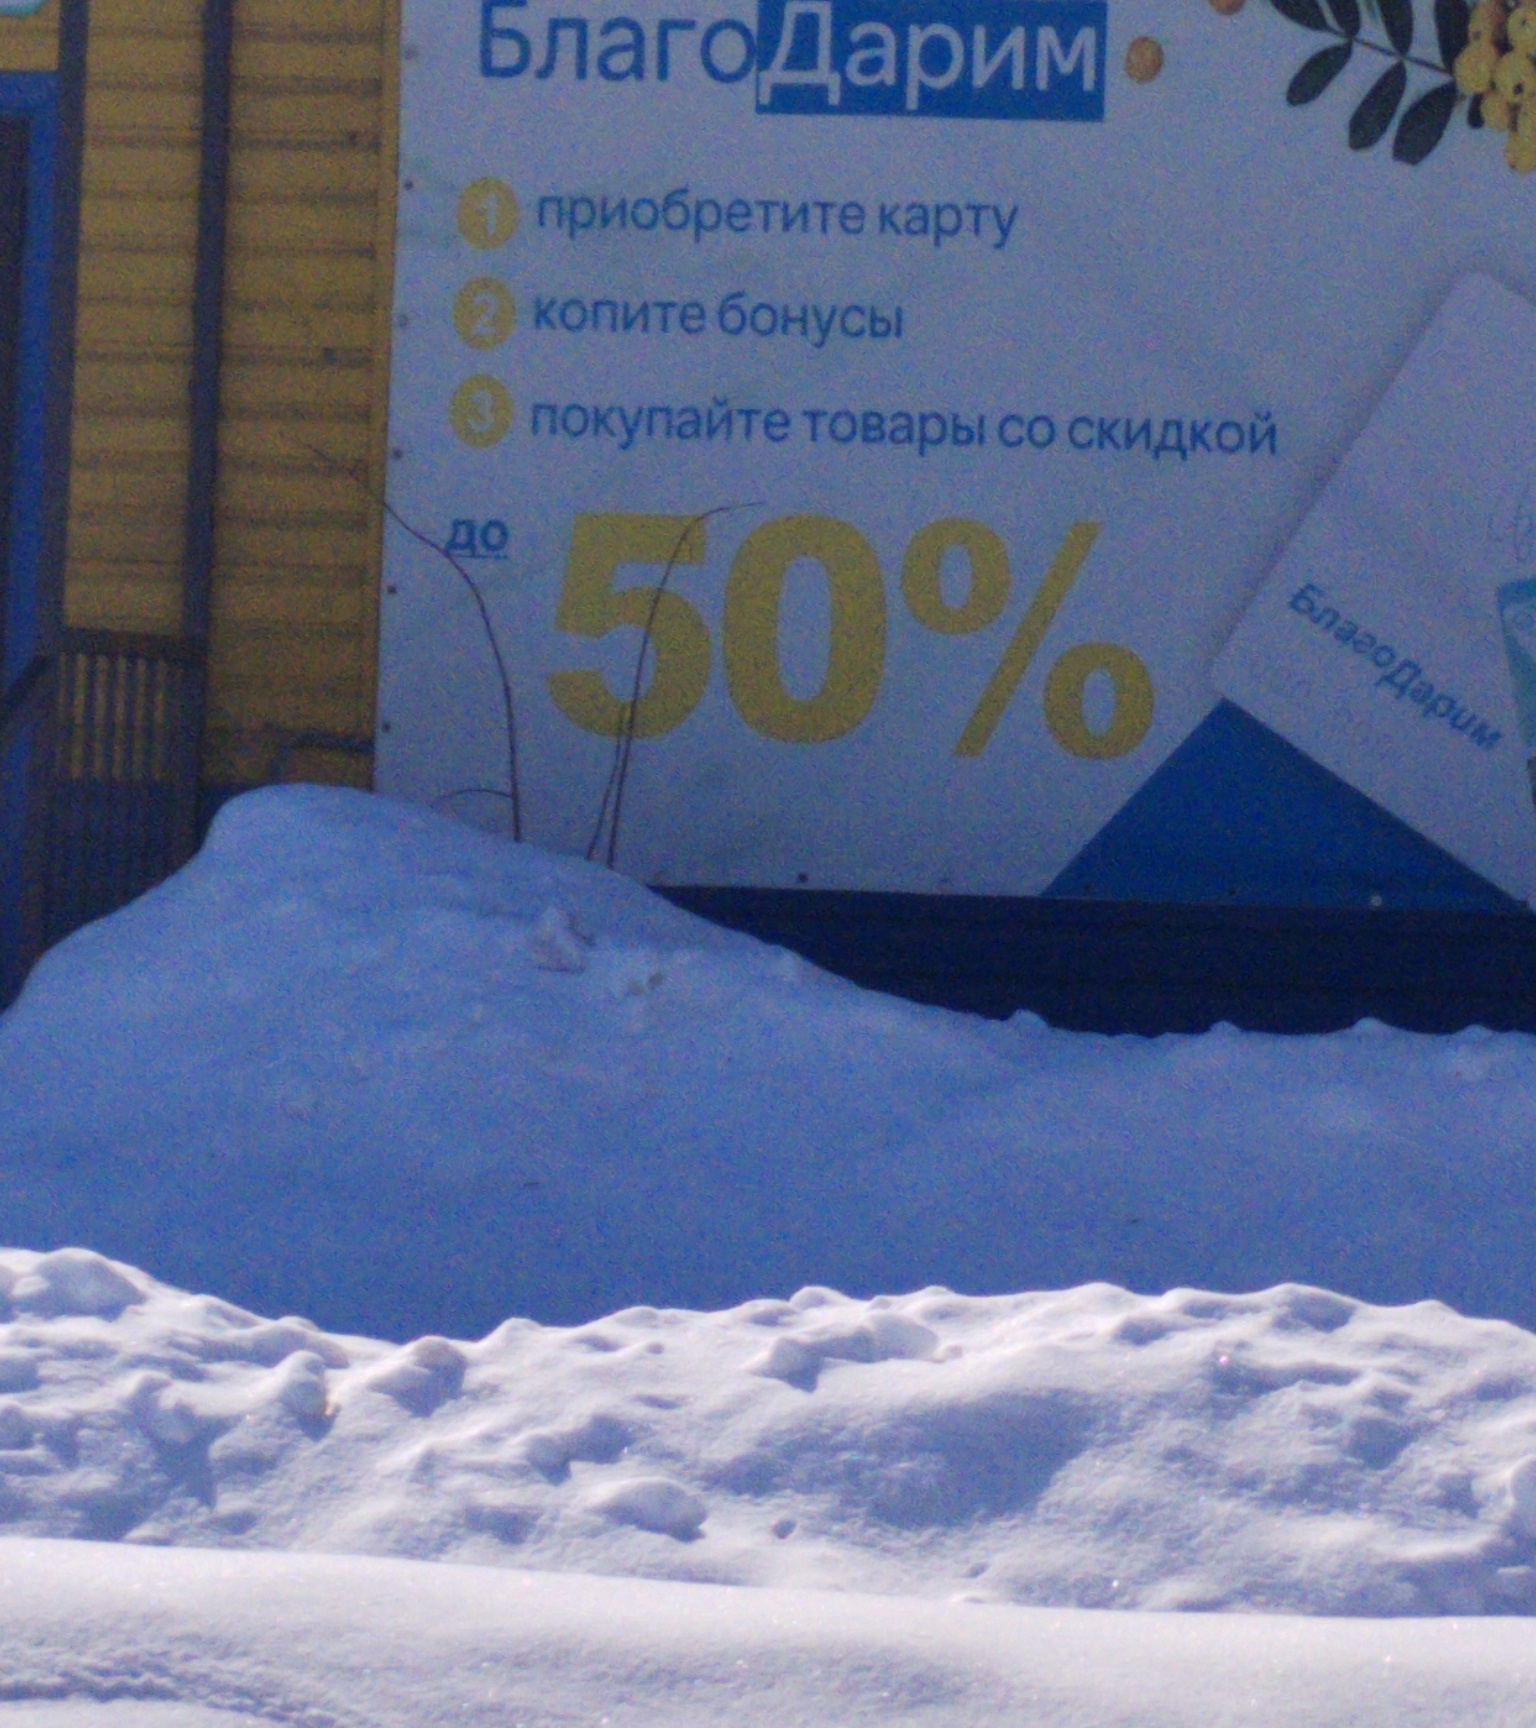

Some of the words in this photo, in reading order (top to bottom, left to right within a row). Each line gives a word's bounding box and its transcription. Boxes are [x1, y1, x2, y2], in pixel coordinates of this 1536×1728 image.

[535, 186, 865, 244] приобретите
[878, 201, 1019, 250] карту
[532, 296, 707, 335] копите
[718, 290, 904, 348] бонусы
[530, 394, 791, 451] покупайте
[802, 408, 986, 457] товары
[997, 414, 1057, 449] со
[1067, 409, 1278, 462] скидкой
[443, 518, 510, 559] до
[544, 509, 1156, 761] 50%
